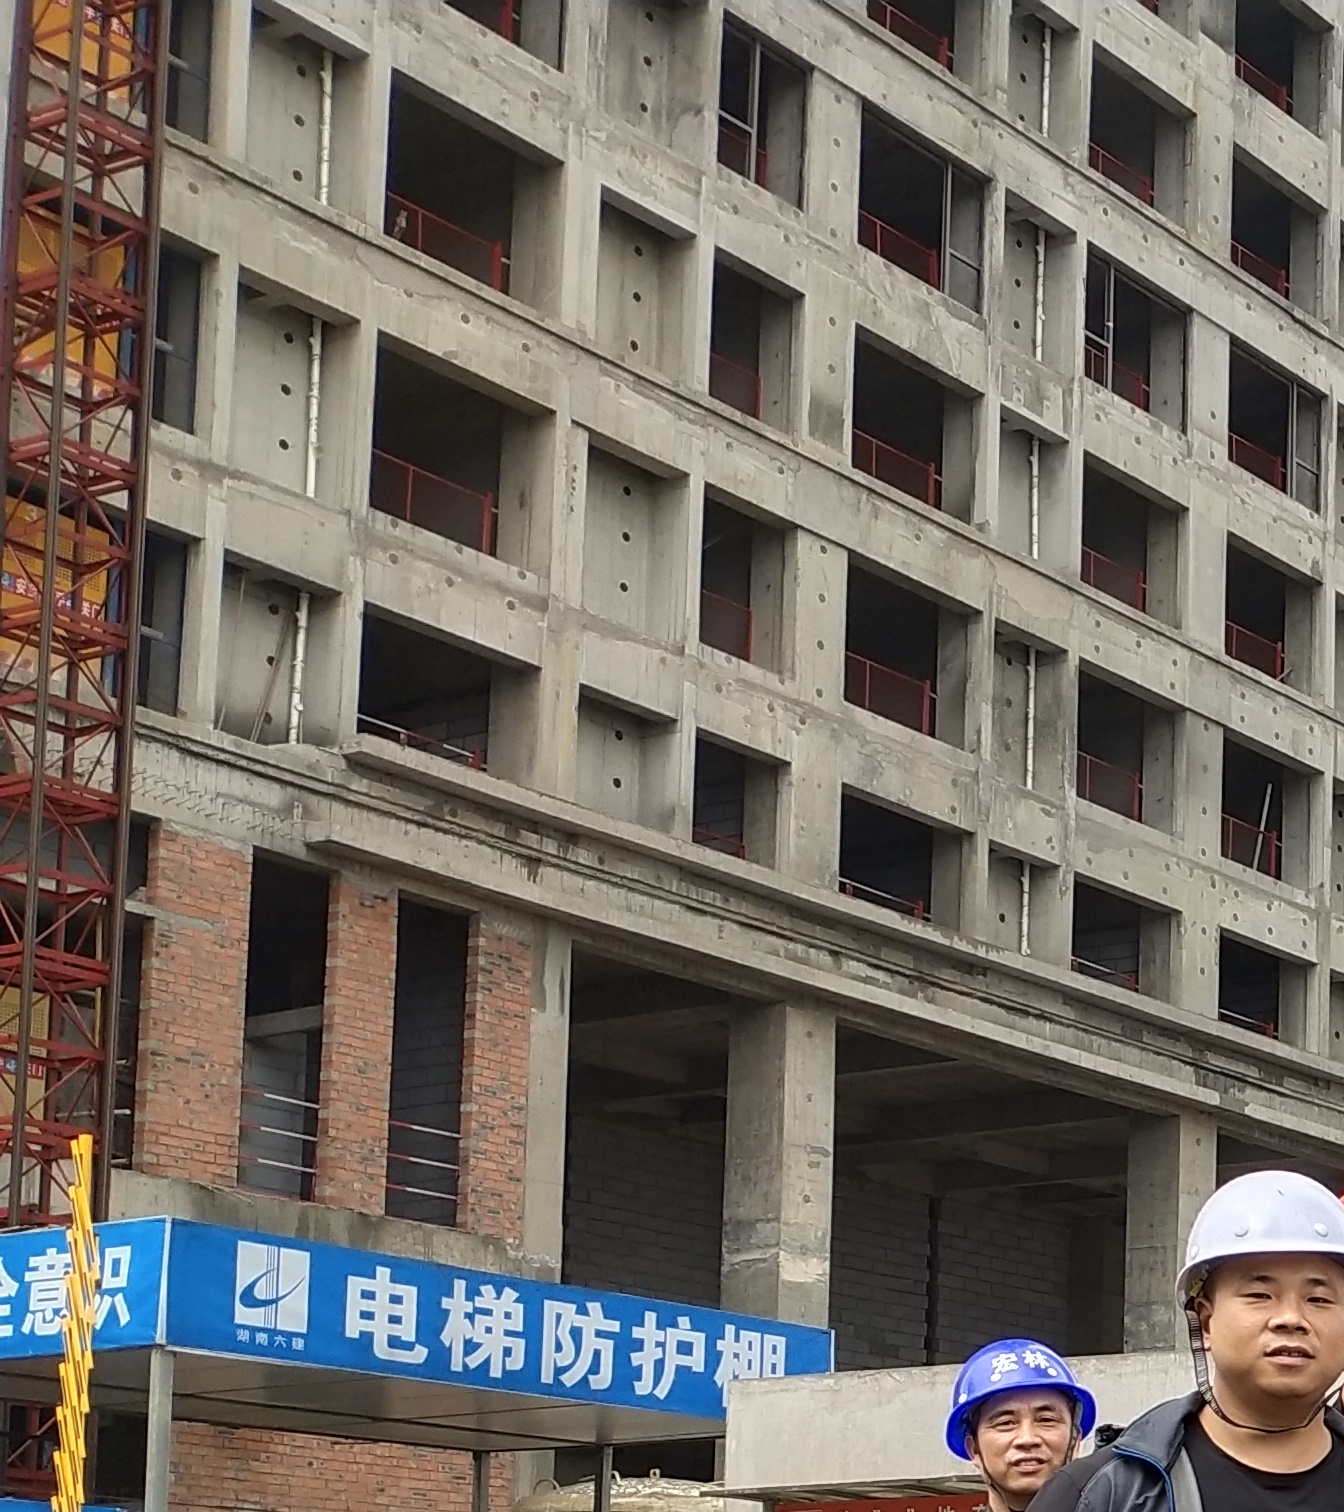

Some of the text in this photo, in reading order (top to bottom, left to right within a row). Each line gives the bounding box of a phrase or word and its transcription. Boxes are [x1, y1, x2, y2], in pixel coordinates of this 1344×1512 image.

[236, 1328, 305, 1351] 湖南六建
[344, 1265, 788, 1408] 电梯防护棚
[991, 1349, 1050, 1373] 宏林
